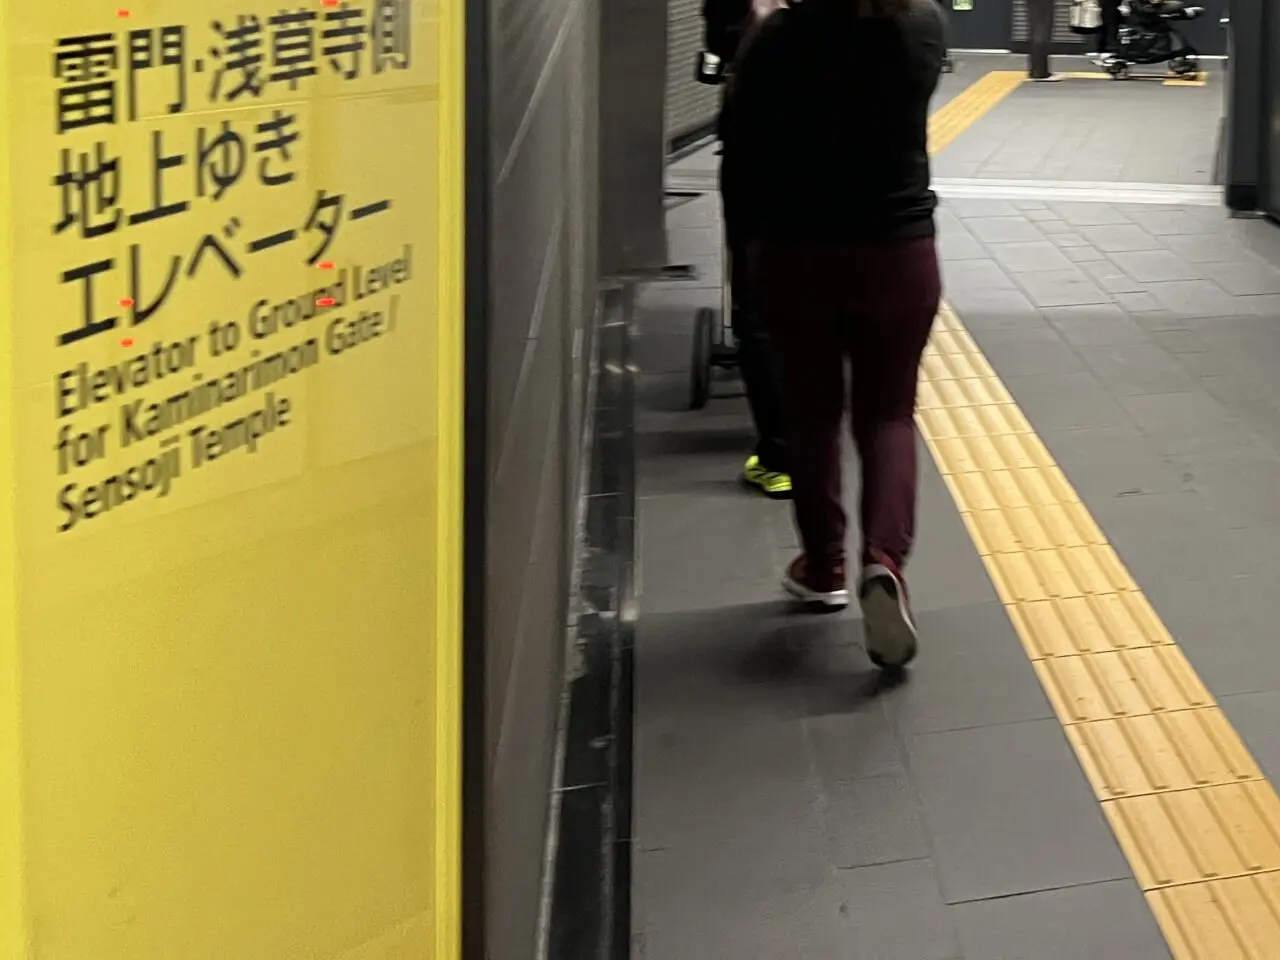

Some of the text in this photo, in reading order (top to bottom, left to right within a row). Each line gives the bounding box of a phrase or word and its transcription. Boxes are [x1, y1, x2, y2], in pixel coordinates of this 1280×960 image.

[51, 109, 301, 239] 地上ゆき
[55, 189, 393, 347] エレベーター
[55, 243, 413, 420] Elevator to Ground Level
[54, 421, 111, 475] for
[121, 335, 319, 449] Kaminarimon
[56, 391, 293, 533] Sensoji Temple
